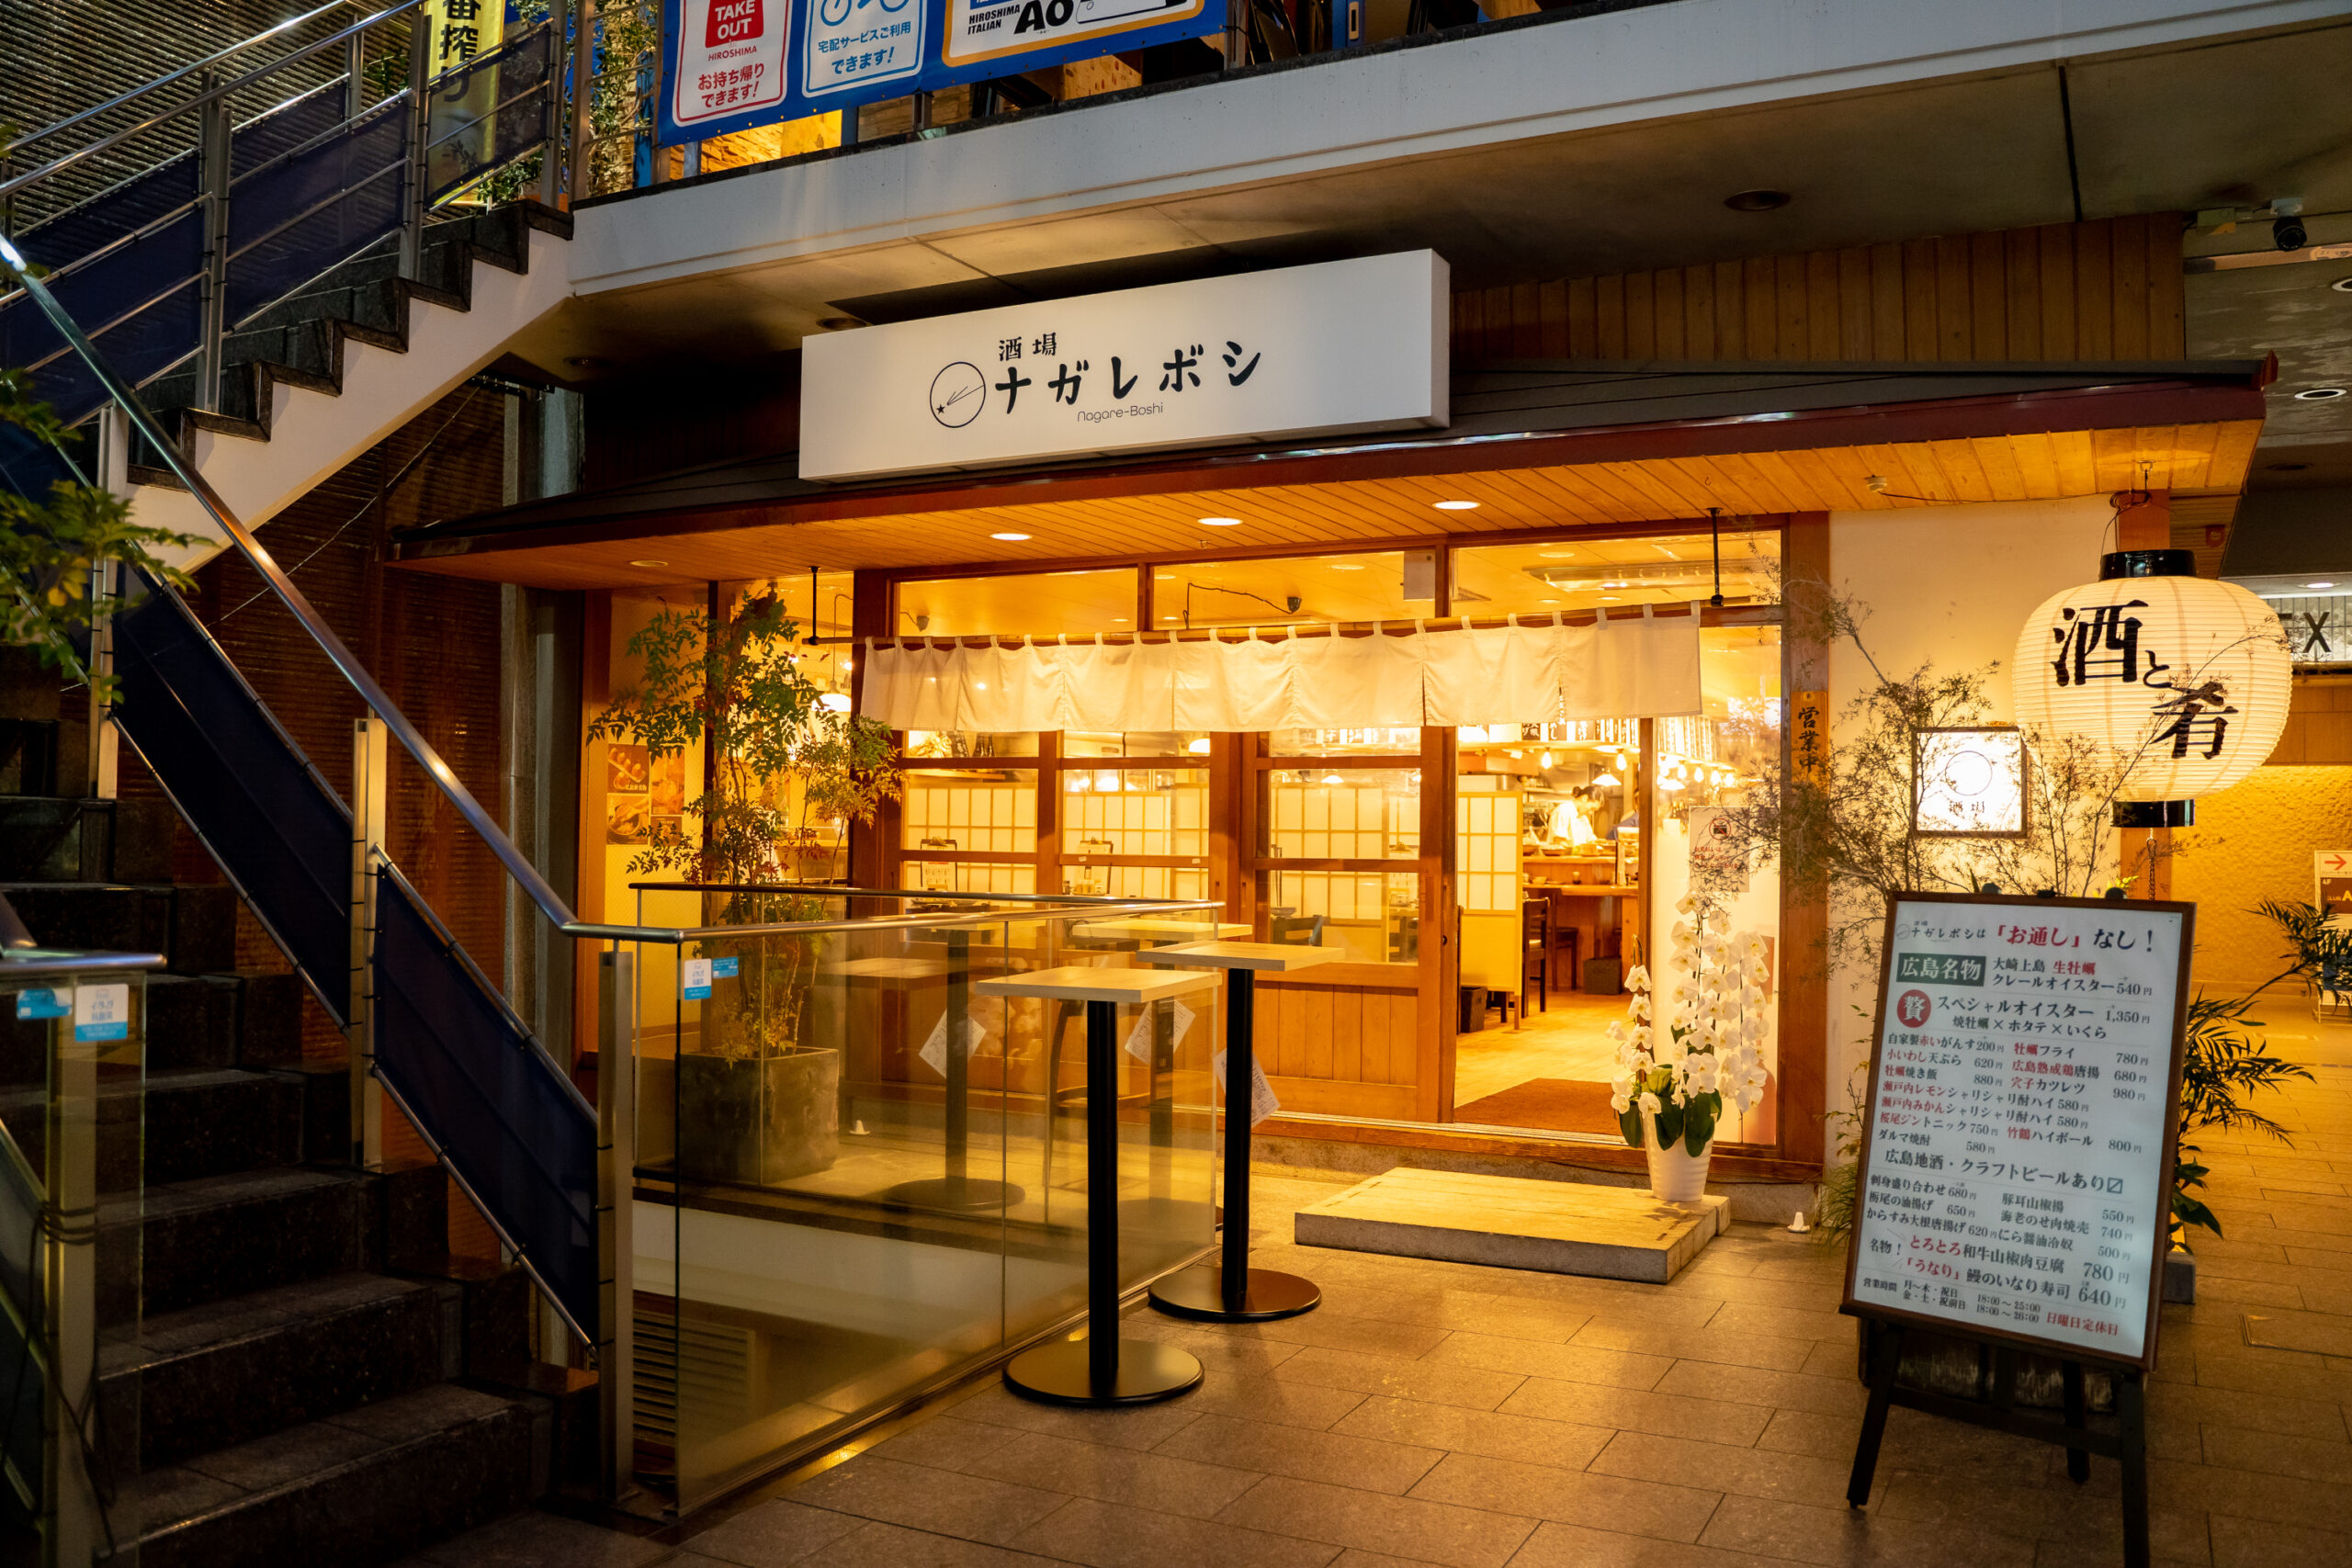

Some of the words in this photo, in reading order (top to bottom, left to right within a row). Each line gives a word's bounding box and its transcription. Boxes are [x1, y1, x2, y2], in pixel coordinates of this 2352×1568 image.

[715, 0, 755, 21] TAKE
[969, 5, 1020, 24] HIROSHIMA
[717, 17, 752, 39] OUT
[818, 21, 911, 53] 宅配サービスご利用
[968, 18, 1001, 35] ITALIAN
[708, 46, 757, 62] HIROSHIMA
[698, 62, 764, 91] お持ち帰り
[999, 333, 1057, 361] 酒場
[995, 340, 1261, 414] ナガレボシ
[1078, 402, 1163, 423] Nagare-Boshi
[1798, 706, 1820, 773] 営業中
[1901, 956, 1982, 981] 広島名物
[1993, 957, 2045, 973] 大崎上島
[1938, 995, 2095, 1019] スペシャルオイスター
[2046, 1312, 2119, 1336] 日曜日定休日
